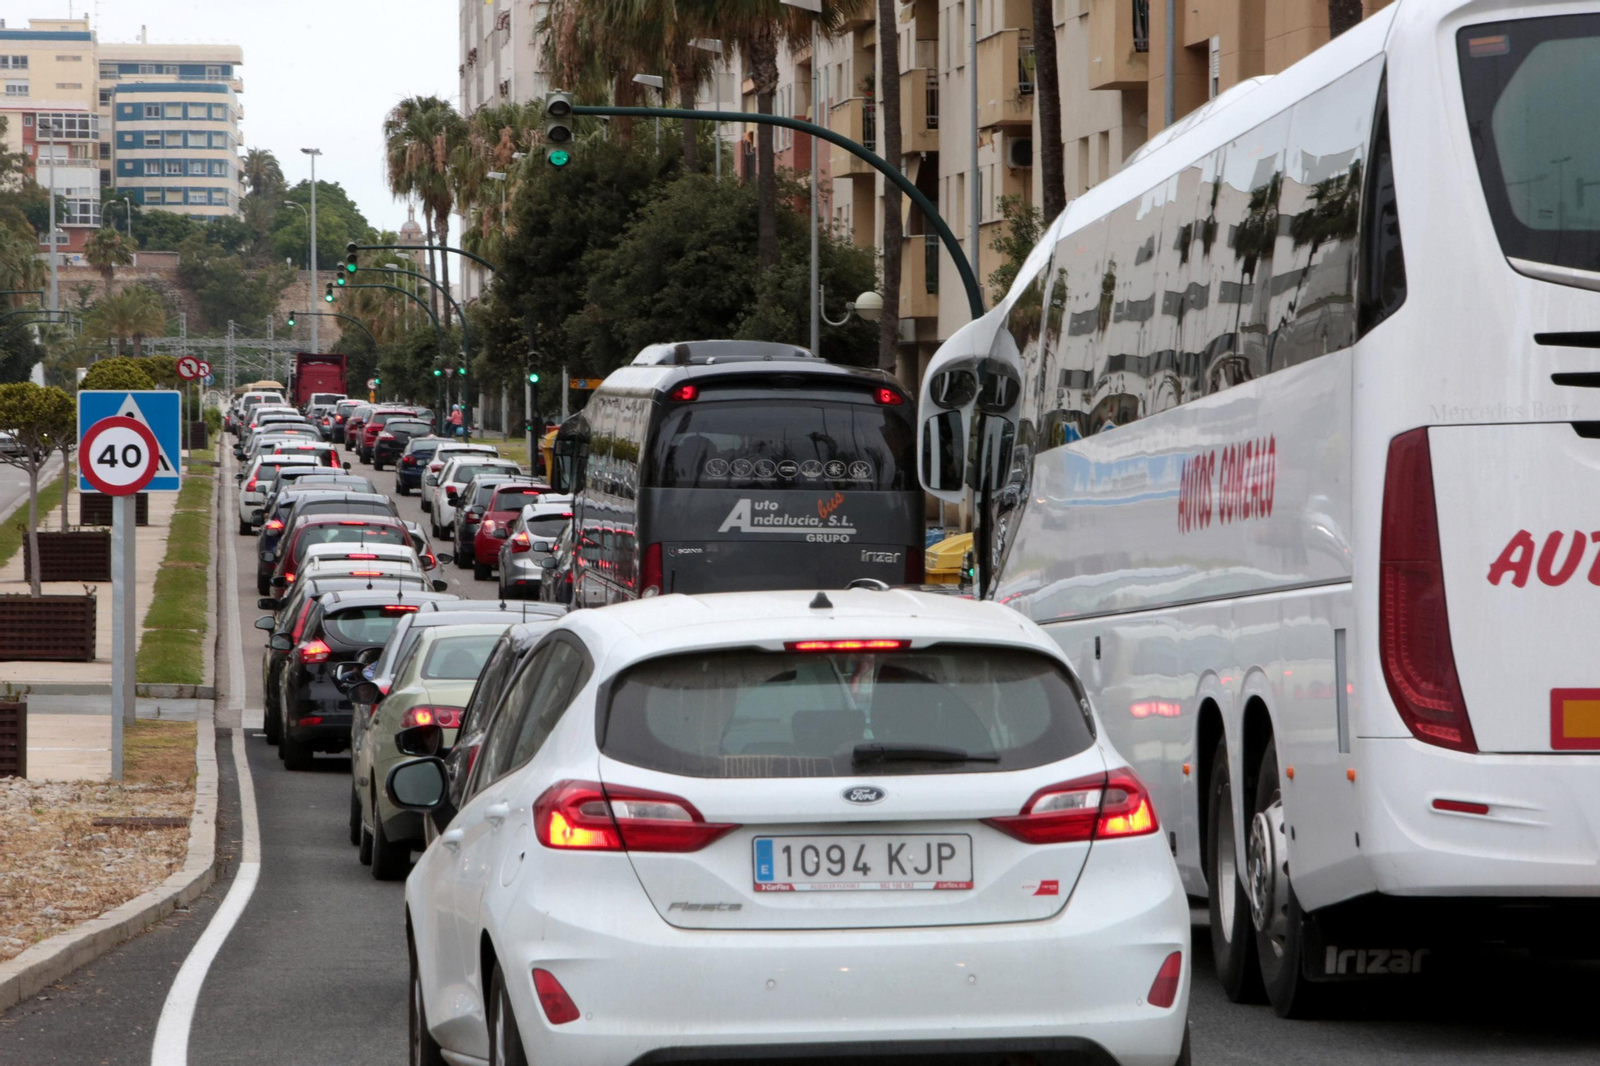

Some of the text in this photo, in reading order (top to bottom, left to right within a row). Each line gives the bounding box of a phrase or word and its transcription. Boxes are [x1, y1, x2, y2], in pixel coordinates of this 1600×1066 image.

[1429, 401, 1580, 422] Mercedes-Benz
[97, 444, 142, 468] 40
[1177, 432, 1276, 535] AUTOS GONZALO
[817, 492, 845, 519] bus
[828, 515, 854, 527] S.L.
[805, 533, 850, 544] GRUPO
[850, 788, 877, 801] Ford
[782, 842, 956, 877] 1094 KJP
[761, 865, 769, 875] E
[667, 901, 743, 912] Fiesta
